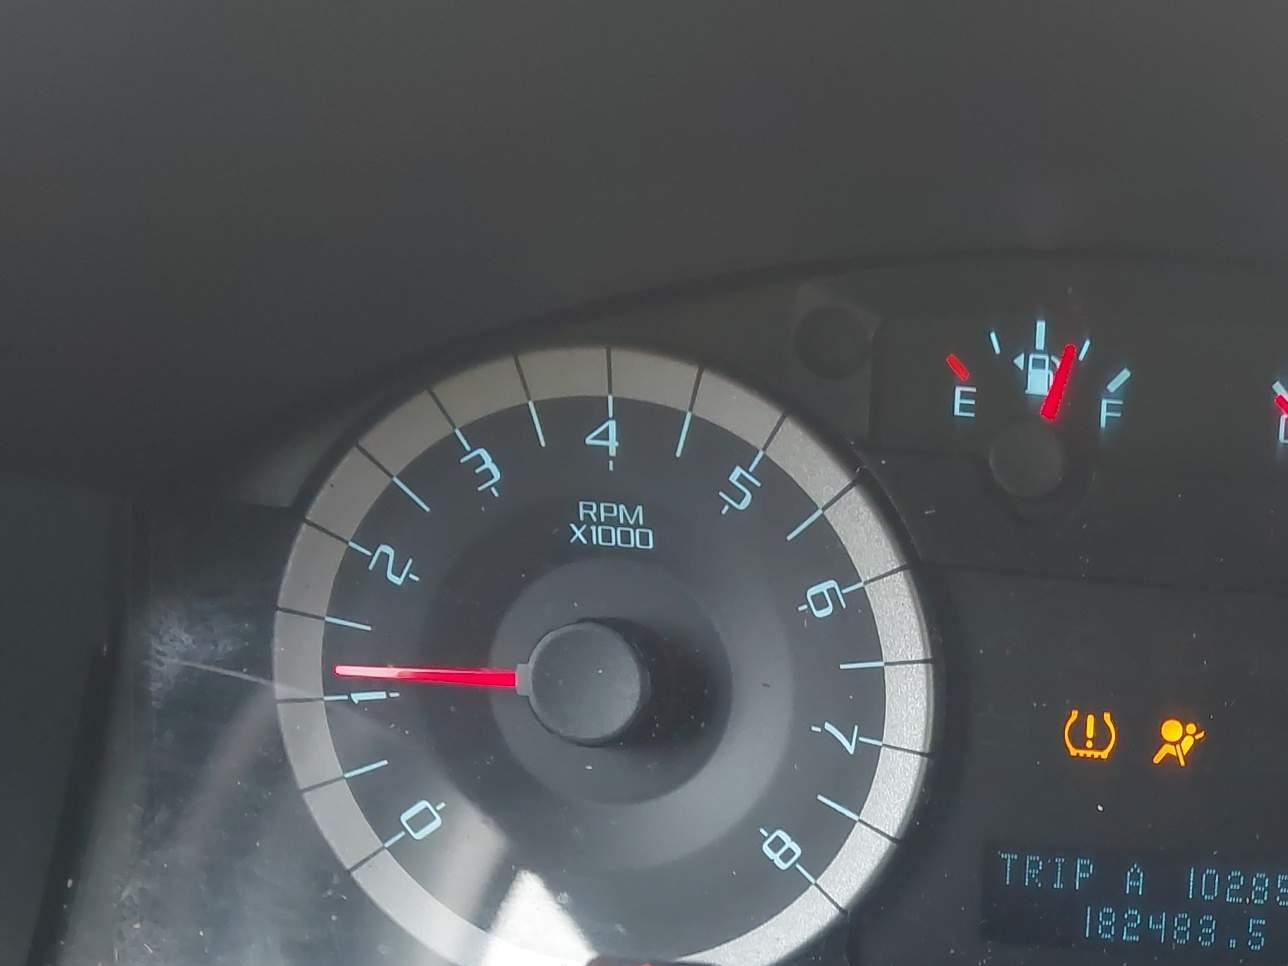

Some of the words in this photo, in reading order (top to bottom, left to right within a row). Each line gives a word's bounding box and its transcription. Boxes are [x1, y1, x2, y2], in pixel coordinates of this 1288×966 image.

[954, 386, 976, 417] E
[1101, 398, 1123, 428] F
[585, 419, 619, 456] 4
[460, 447, 501, 492] 3
[719, 465, 761, 510] 5
[578, 501, 644, 526] RPM
[569, 523, 654, 549] X1000
[369, 544, 415, 585] 2
[806, 579, 847, 618] 6
[350, 691, 387, 704] 1
[823, 721, 858, 755] 7
[400, 800, 441, 839] 0
[762, 830, 801, 870] 8
[1000, 852, 1093, 890] TRIP
[1125, 864, 1143, 895] A
[1085, 906, 1266, 950] 182483.5
